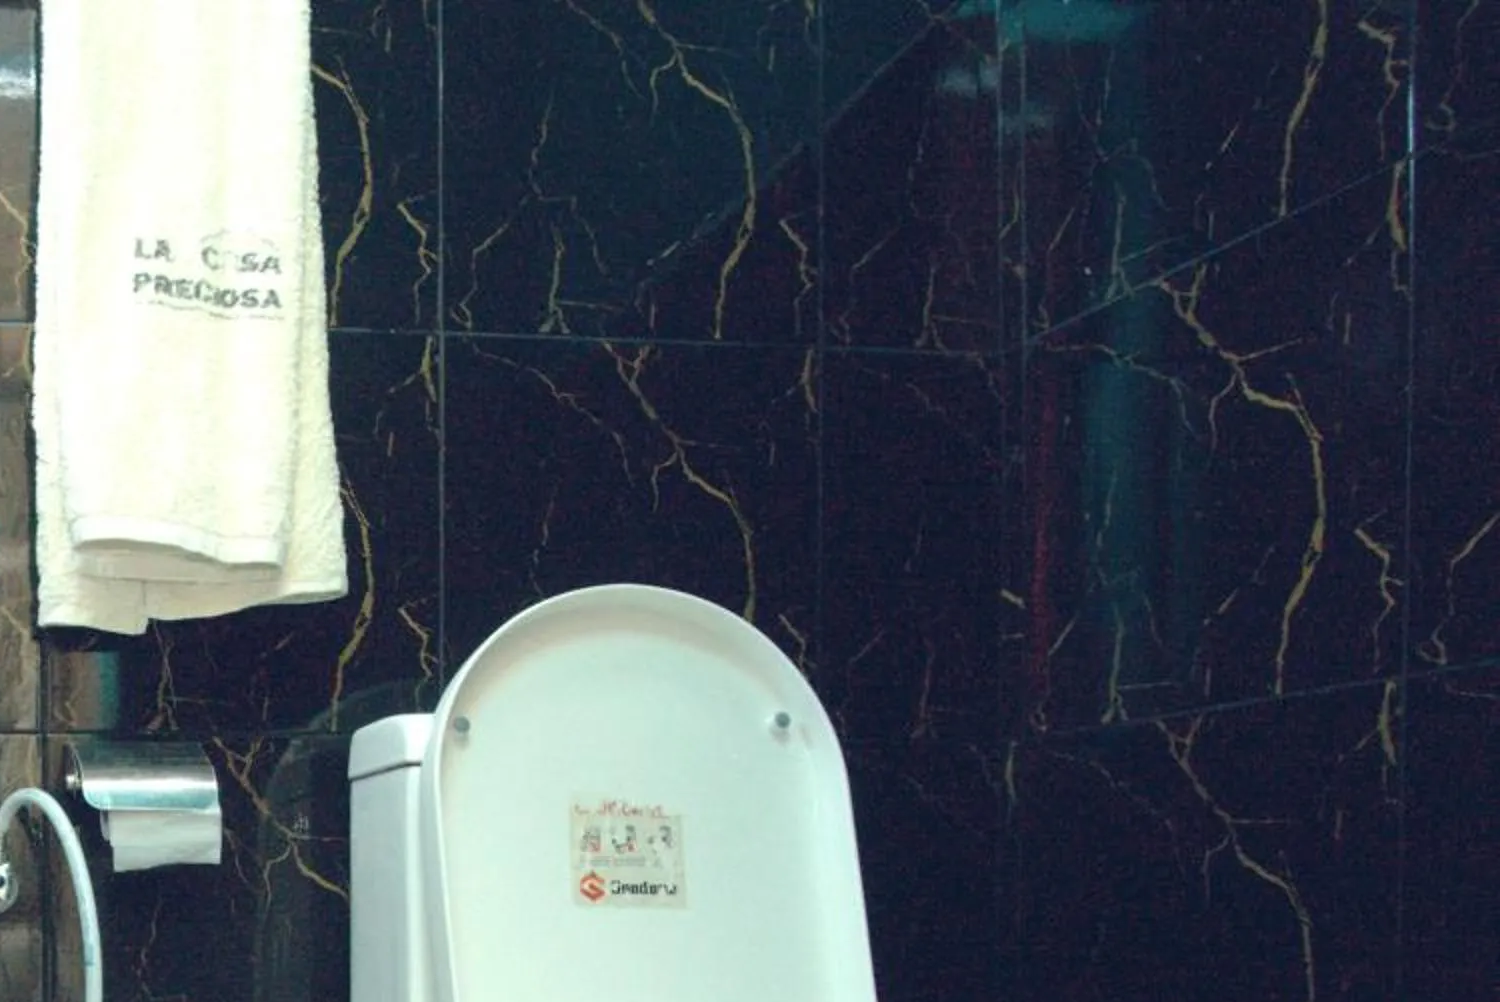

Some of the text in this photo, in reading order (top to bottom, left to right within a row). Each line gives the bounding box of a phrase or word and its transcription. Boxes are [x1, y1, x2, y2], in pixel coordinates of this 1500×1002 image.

[134, 238, 282, 275] LA CSA
[133, 272, 283, 309] PRECIOSA
